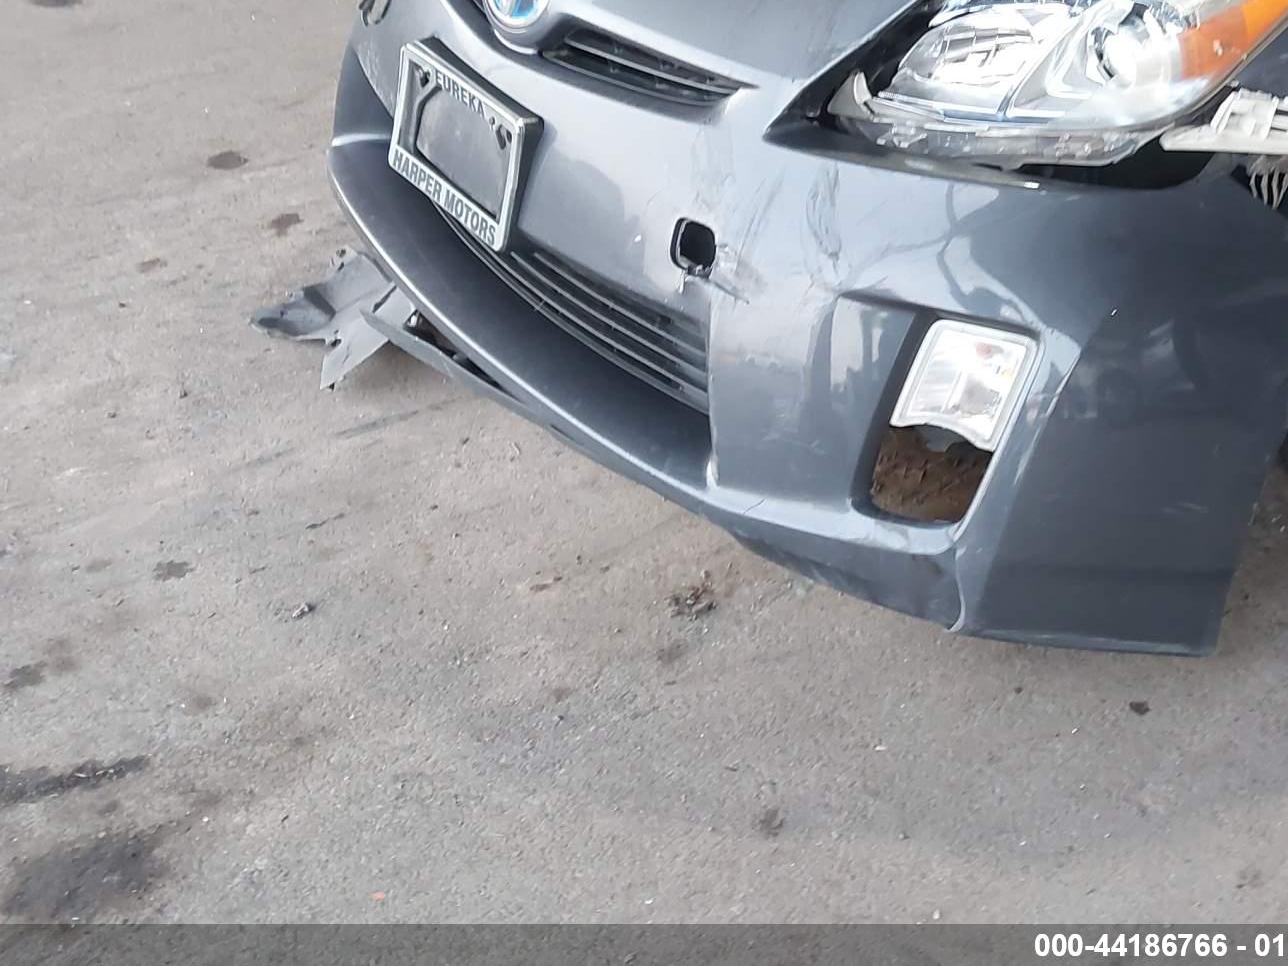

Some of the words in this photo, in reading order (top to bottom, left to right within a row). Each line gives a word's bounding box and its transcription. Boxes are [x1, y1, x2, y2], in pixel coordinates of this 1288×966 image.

[435, 69, 485, 121] EUREKA
[392, 148, 442, 203] HARPER
[443, 189, 496, 246] MOTORS
